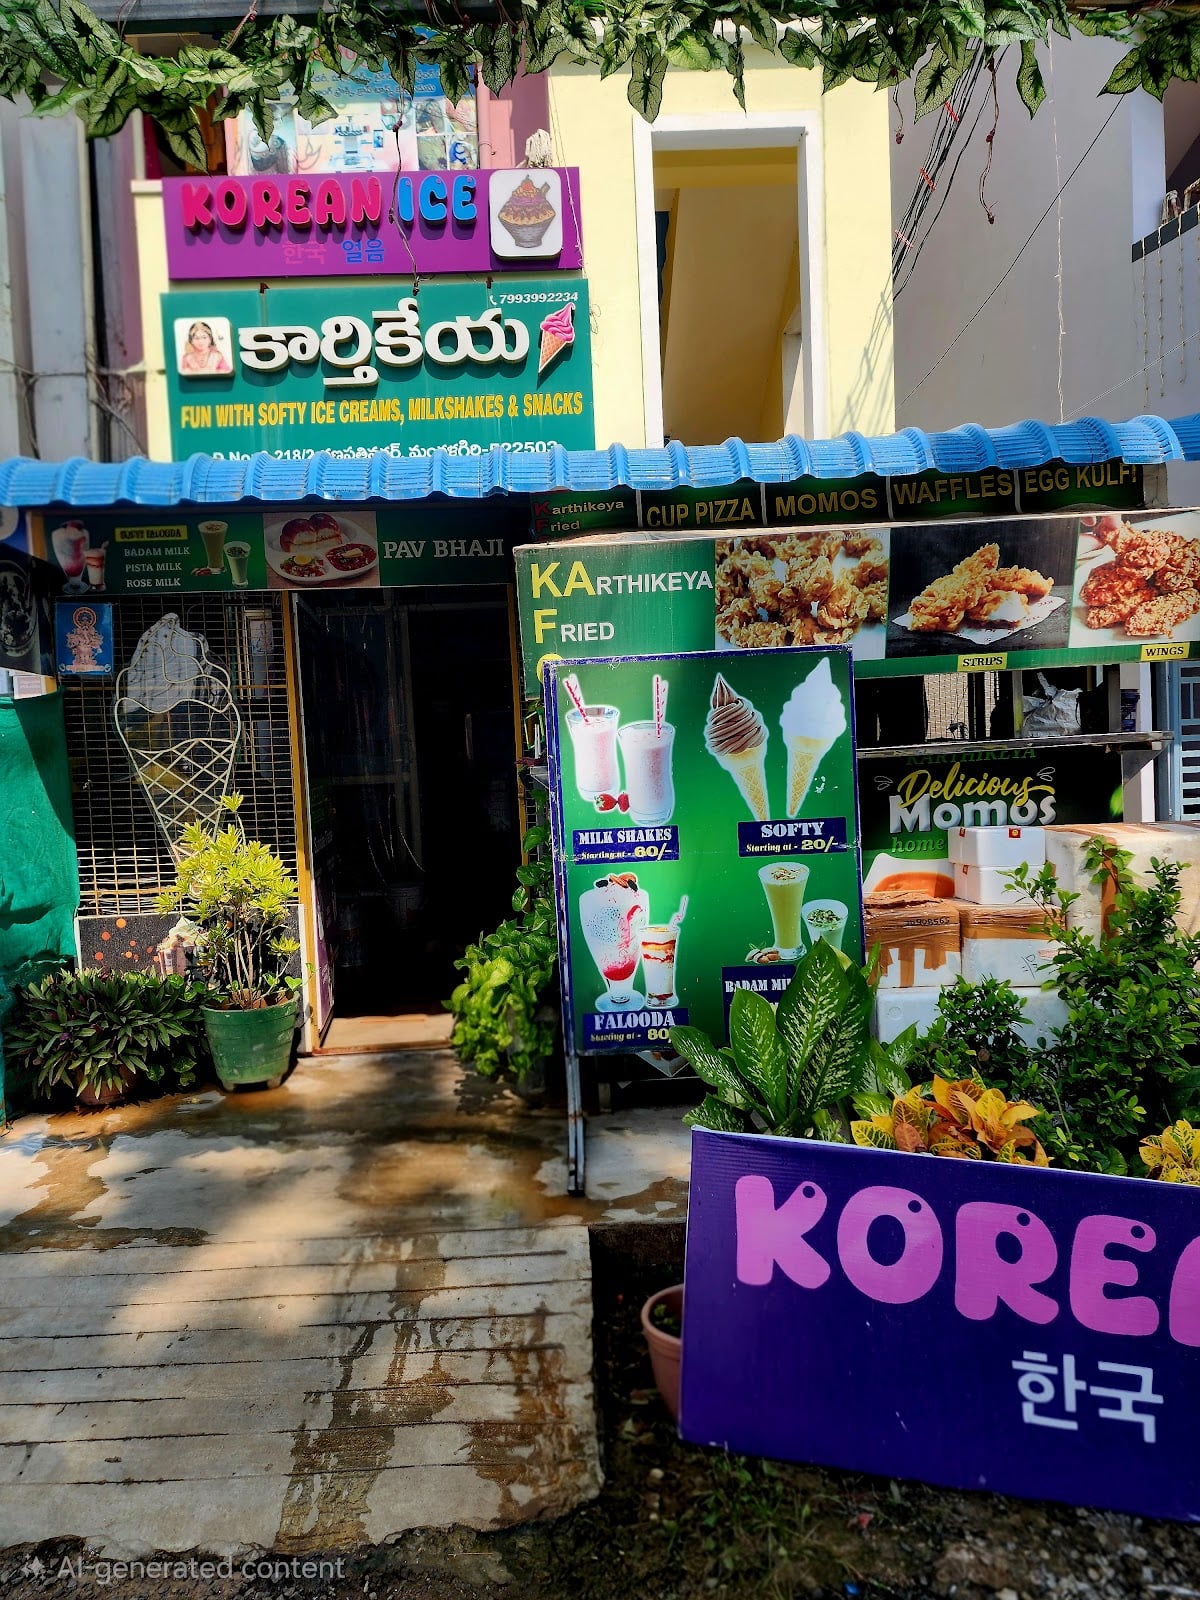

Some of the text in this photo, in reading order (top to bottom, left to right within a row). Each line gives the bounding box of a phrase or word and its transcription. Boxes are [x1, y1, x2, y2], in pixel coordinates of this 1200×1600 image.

[180, 174, 478, 228] KOREAN ICE
[282, 238, 385, 264] 한국 얼음
[500, 292, 579, 304] 7993992234
[238, 297, 530, 388] కార్తికేయ
[181, 391, 583, 428] FUN WITH SOFTY ICE CREAMS, MILKSHAKES & SNACKS
[1024, 462, 1137, 493] EGG KULFI
[894, 473, 1013, 505] WAFFLES
[533, 500, 625, 516] Karthikeya
[775, 488, 878, 517] MOMOS
[647, 498, 756, 527] CUP PIZZA
[535, 518, 581, 532] Fried
[124, 546, 191, 557] BADAM MILK
[383, 538, 505, 558] PAV BHAJI
[125, 562, 182, 572] PISTA MILK
[126, 577, 181, 588] ROSE MILK
[531, 560, 713, 599] KARTHIKEYA
[1145, 646, 1184, 657] WINGS
[962, 656, 1003, 667] STRIPS
[897, 762, 1055, 807] Delicious
[889, 794, 1056, 833] Momos
[579, 828, 672, 844] MILK SHAKES
[761, 822, 825, 838] SOFTY
[581, 851, 616, 860] Starting
[634, 843, 672, 860] 60/-
[746, 843, 780, 852] Starting
[801, 836, 838, 852] 20/-
[892, 837, 944, 853] home
[725, 980, 768, 993] BADAM
[594, 1010, 676, 1030] FALOODA
[647, 1028, 672, 1043] 80
[1012, 1350, 1164, 1443] 한국
